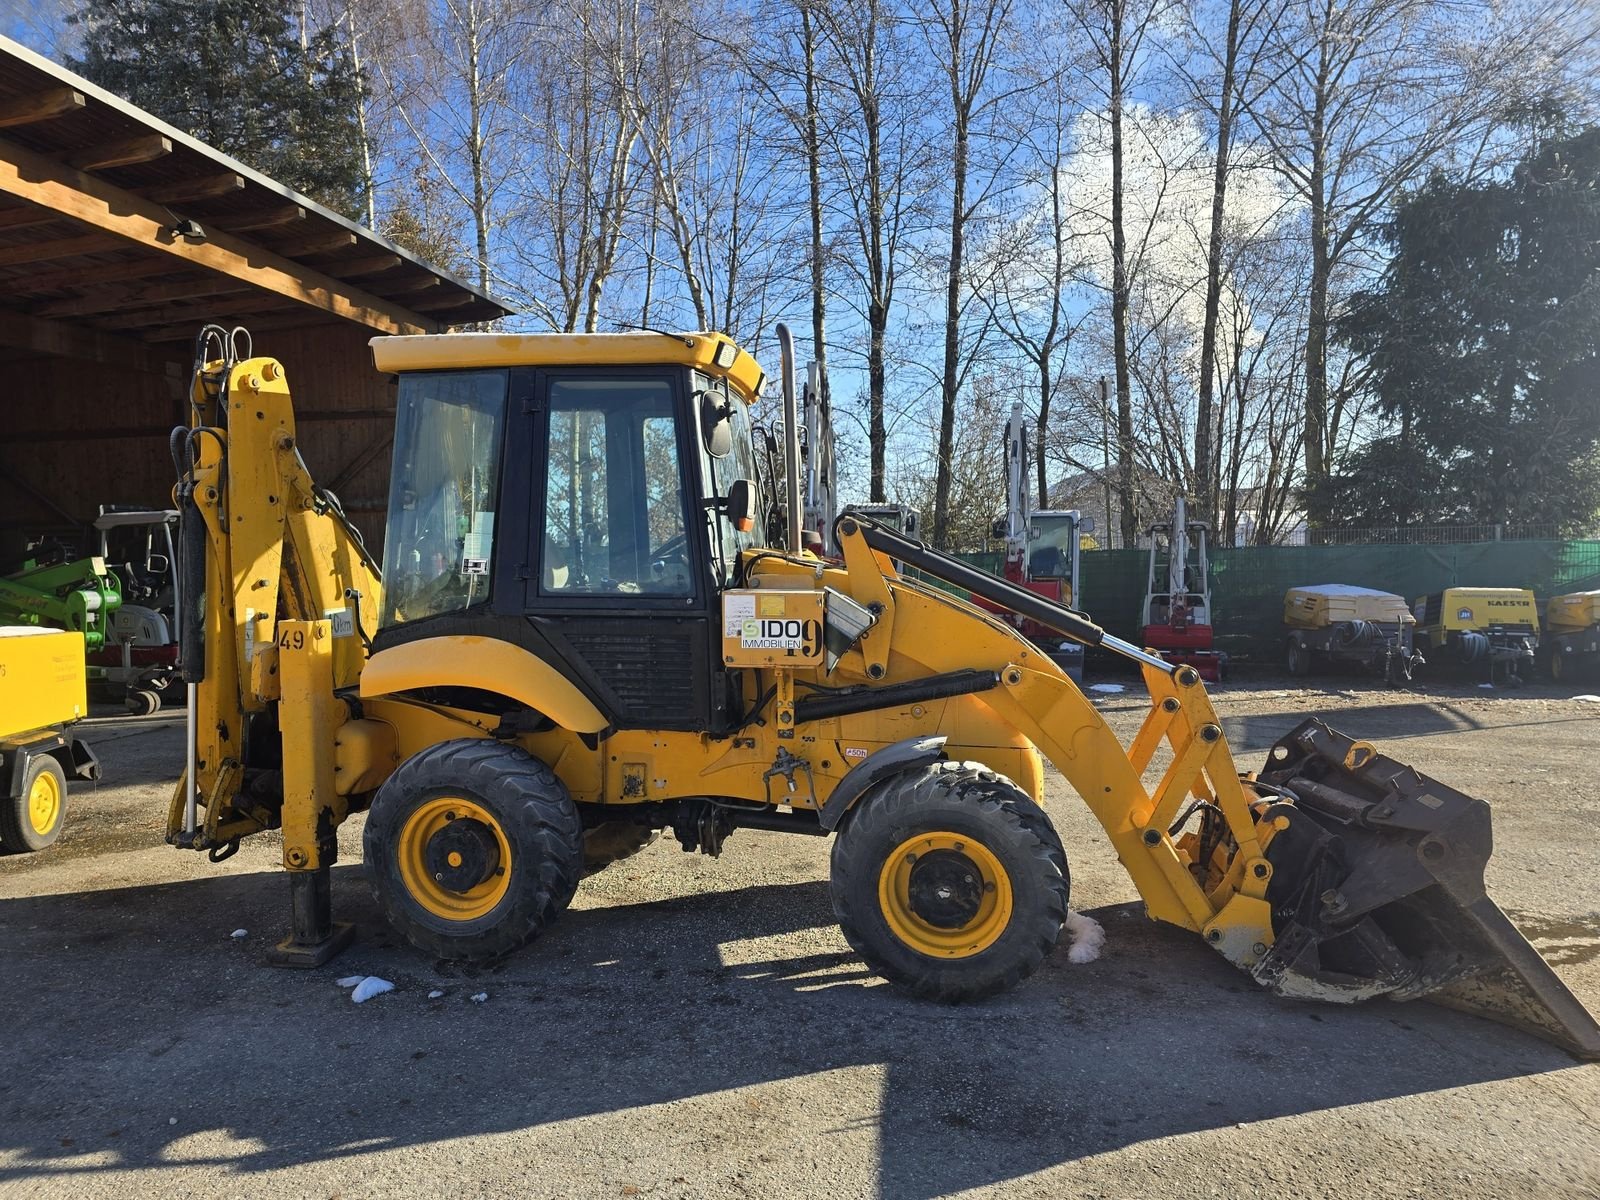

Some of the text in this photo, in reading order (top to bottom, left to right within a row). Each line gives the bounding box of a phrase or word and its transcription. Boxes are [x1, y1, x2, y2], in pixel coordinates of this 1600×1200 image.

[743, 619, 801, 638] SIDO
[280, 630, 304, 650] 49
[743, 639, 801, 648] IMMOBILIEN
